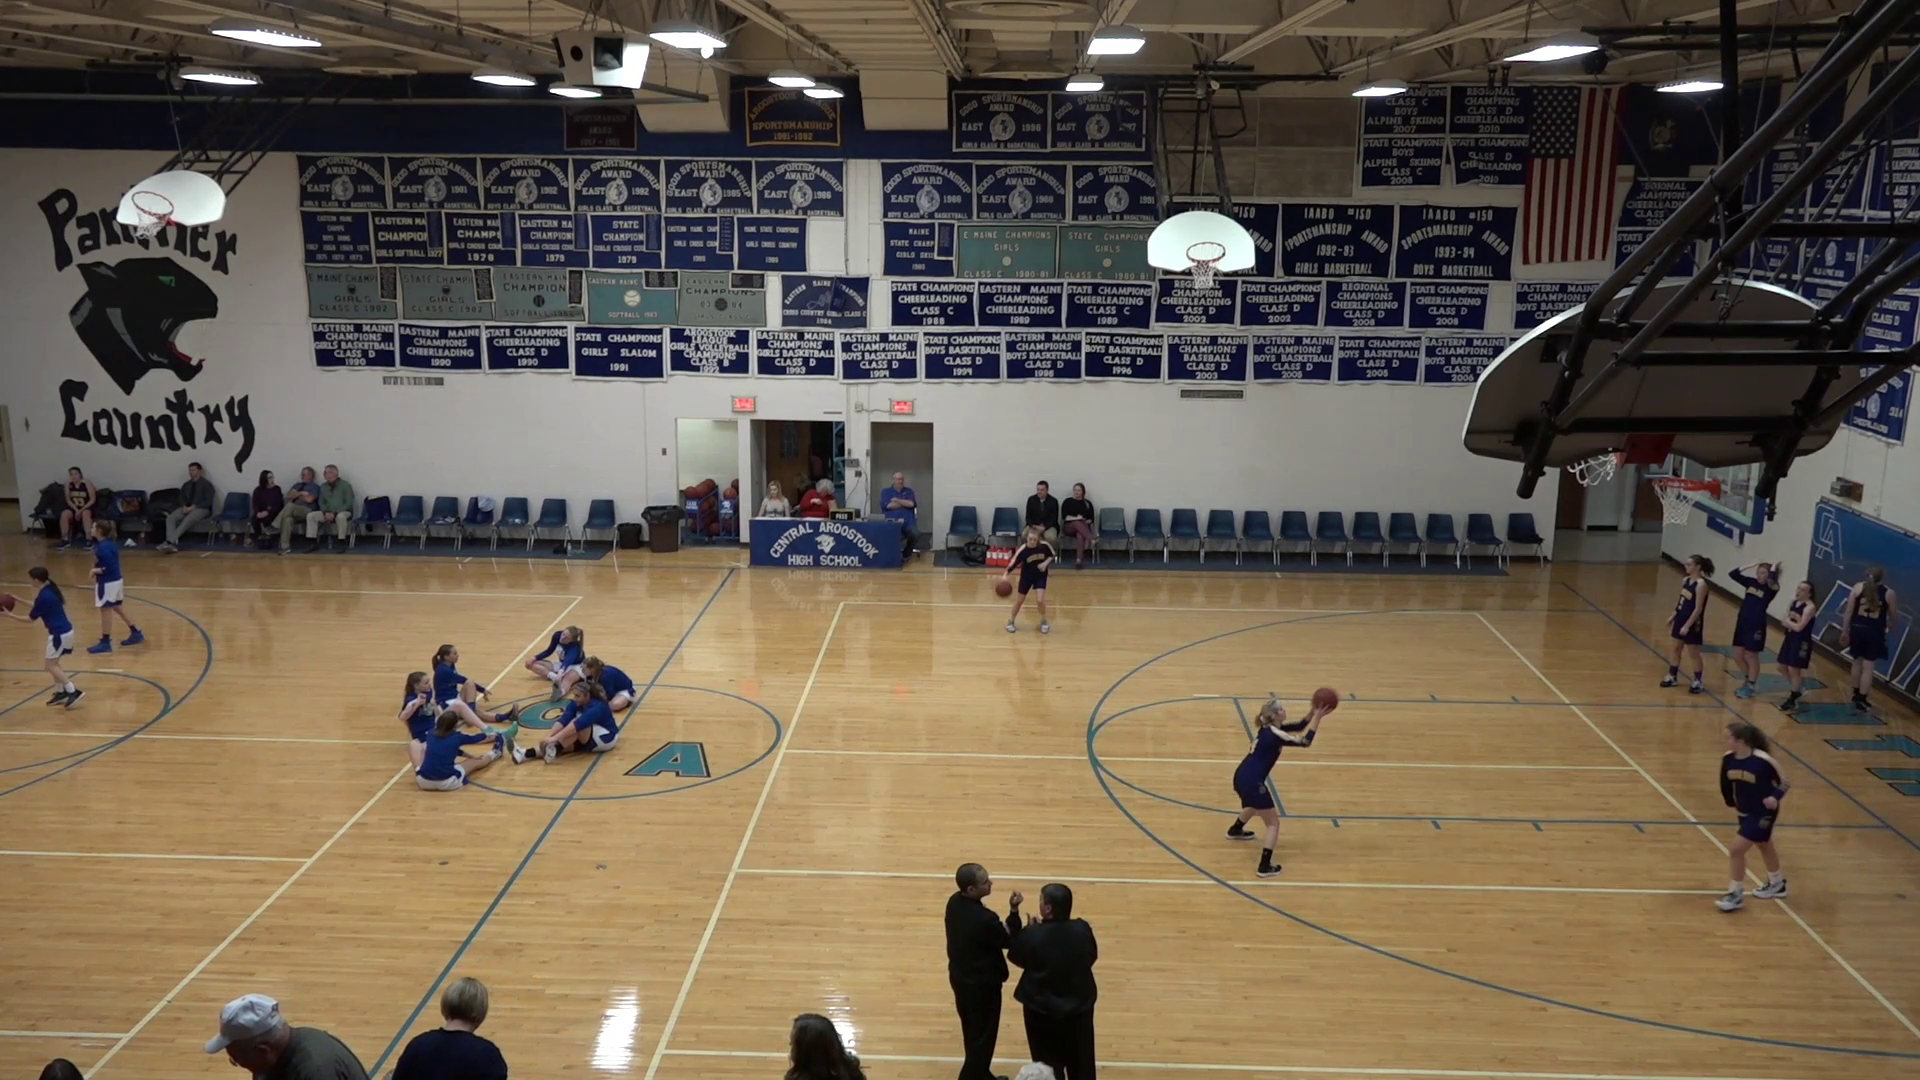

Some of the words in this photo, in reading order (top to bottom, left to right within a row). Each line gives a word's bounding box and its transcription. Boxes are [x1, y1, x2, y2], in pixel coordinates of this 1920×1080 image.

[1464, 97, 1520, 106] CHAMPIONS
[1394, 107, 1418, 116] BOYS
[1467, 106, 1497, 115] CLASS
[1366, 116, 1402, 125] ALPINE
[1410, 116, 1445, 125] SKIING
[1454, 115, 1525, 124] CHEERLEADING
[1393, 125, 1417, 134] 2007
[1478, 125, 1501, 134] 2010
[1363, 138, 1389, 148] STATE
[1391, 138, 1443, 148] CHAMPIONS
[1479, 139, 1529, 148] CHAMPIONS
[1391, 148, 1415, 157] BOYS
[1363, 159, 1398, 168] ALPINE
[1409, 159, 1441, 168] SKIING
[1460, 161, 1523, 172] CHEERLEADING
[326, 166, 357, 175] AWARD
[601, 170, 632, 178] AWARD
[785, 171, 815, 180] AWARD
[1380, 169, 1410, 178] CLASS
[902, 164, 972, 194] SPORTSMANSHIP
[912, 176, 943, 185] AWARD
[307, 184, 331, 193] EAST
[582, 187, 606, 195] EAST
[765, 190, 789, 198] EAST
[891, 195, 915, 203] EAST
[1304, 208, 1335, 220] IAABO
[1422, 208, 1456, 221] IAABO
[612, 220, 640, 230] STATE
[41, 188, 237, 275] Paner
[973, 230, 999, 240] MAINE
[1005, 230, 1052, 241] CHAMPIONS
[1285, 222, 1352, 252] SPORTSMANSHIP
[1400, 223, 1474, 251] SPORTSMANSHIP
[994, 243, 1020, 252] GIRLS
[1295, 261, 1319, 275] GIRLS
[1324, 262, 1373, 276] BASKETBALL
[1413, 263, 1435, 276] BOYS
[1441, 264, 1494, 278] BASKETBALL
[891, 283, 917, 293] STATE
[920, 283, 975, 294] CHAMPIONS
[979, 285, 1021, 294] EASTERN
[1029, 285, 1061, 295] MAINE
[1067, 285, 1092, 295] STATE
[1097, 285, 1152, 296] CHAMPIONS
[1241, 284, 1266, 293] STATE
[1268, 284, 1322, 295] CHAMPIONS
[1342, 282, 1390, 292] REGIONAL
[1411, 285, 1435, 295] STATE
[1437, 284, 1488, 296] CHAMPIONS
[898, 295, 967, 305] CHEERLEADING
[993, 295, 1048, 305] CHAMPIONS
[1074, 295, 1144, 306] CHEERLEADING
[1160, 297, 1232, 307] CHEERLEADING
[1246, 295, 1315, 304] CHEERLEADING
[1337, 292, 1393, 302] CHAMPIONS
[1416, 296, 1482, 306] CHEERLEADING
[1527, 292, 1587, 302] CHAMPIONS
[911, 306, 940, 316] CLASS
[985, 305, 1055, 315] CHEERLEADING
[1086, 305, 1116, 315] CLASS
[1174, 306, 1204, 315] CLASS
[1259, 304, 1288, 314] CLASS
[1330, 301, 1399, 311] CHEERLEADING
[1428, 306, 1457, 316] CLASS
[1182, 314, 1207, 324] 2002
[1267, 314, 1291, 324] 2002
[1343, 310, 1373, 319] CLASS
[313, 323, 354, 333] EASTERN
[362, 323, 394, 333] MAINE
[400, 327, 439, 337] EASTERN
[447, 328, 480, 338] MAINE
[485, 328, 510, 338] STATE
[514, 328, 568, 338] CHAMPIONS
[325, 332, 382, 342] CHAMPIONS
[576, 333, 602, 343] STATE
[607, 333, 662, 344] CHAMPIONS
[757, 331, 798, 341] EASTERN
[804, 332, 834, 341] MAINE
[888, 333, 918, 343] MAINE
[924, 335, 949, 345] STATE
[951, 334, 1001, 345] CHAMPIONS
[1168, 335, 1210, 345] EASTERN
[1254, 335, 1295, 346] EASTERN
[1304, 336, 1335, 346] MAINE
[313, 341, 338, 351] GIRLS
[340, 341, 395, 351] BASKETBALL
[413, 338, 468, 348] CHAMPIONS
[493, 338, 561, 348] CHEERLEADING
[767, 340, 823, 351] CHAMPIONS
[1113, 336, 1163, 347] CHAMPIONS
[1340, 338, 1365, 348] STATE
[1368, 338, 1421, 349] CHAMPIONS
[1473, 338, 1503, 347] MAINE
[924, 344, 946, 355] BOYS
[949, 344, 1001, 355] BASKETBALL
[1016, 342, 1072, 352] CHAMPIONS
[1109, 345, 1163, 356] BASKETBALL
[1179, 345, 1237, 355] CHAMPIONS
[1264, 345, 1322, 355] CHAMPIONS
[1435, 346, 1493, 356] CHAMPIONS
[333, 350, 362, 359] CLASS
[406, 347, 474, 358] CHEERLEADING
[506, 348, 535, 358] CLASS
[581, 347, 609, 358] GIRLS
[619, 347, 657, 359] SLALOM
[683, 351, 737, 361] CHAMPIONS
[782, 348, 835, 359] BASKETBALL
[866, 351, 917, 361] BASKETBALL
[1006, 351, 1028, 361] BOYS
[1339, 348, 1360, 359] BOYS
[1364, 348, 1420, 359] BASKETBALL
[775, 358, 804, 368] CLASS
[944, 356, 972, 366] CLASS
[1183, 353, 1232, 363] BASEBALL
[1254, 353, 1276, 363] BOYS
[1281, 354, 1333, 364] BASKETBALL
[1425, 355, 1446, 366] BOYS
[609, 362, 629, 373] 1991
[1271, 362, 1302, 372] CLASS
[1356, 359, 1386, 369] CLASS
[769, 521, 814, 559] CENTRAL
[819, 522, 879, 559] AROOSTOOK
[788, 555, 814, 566] HIGH
[819, 555, 863, 567] SCHOOL
